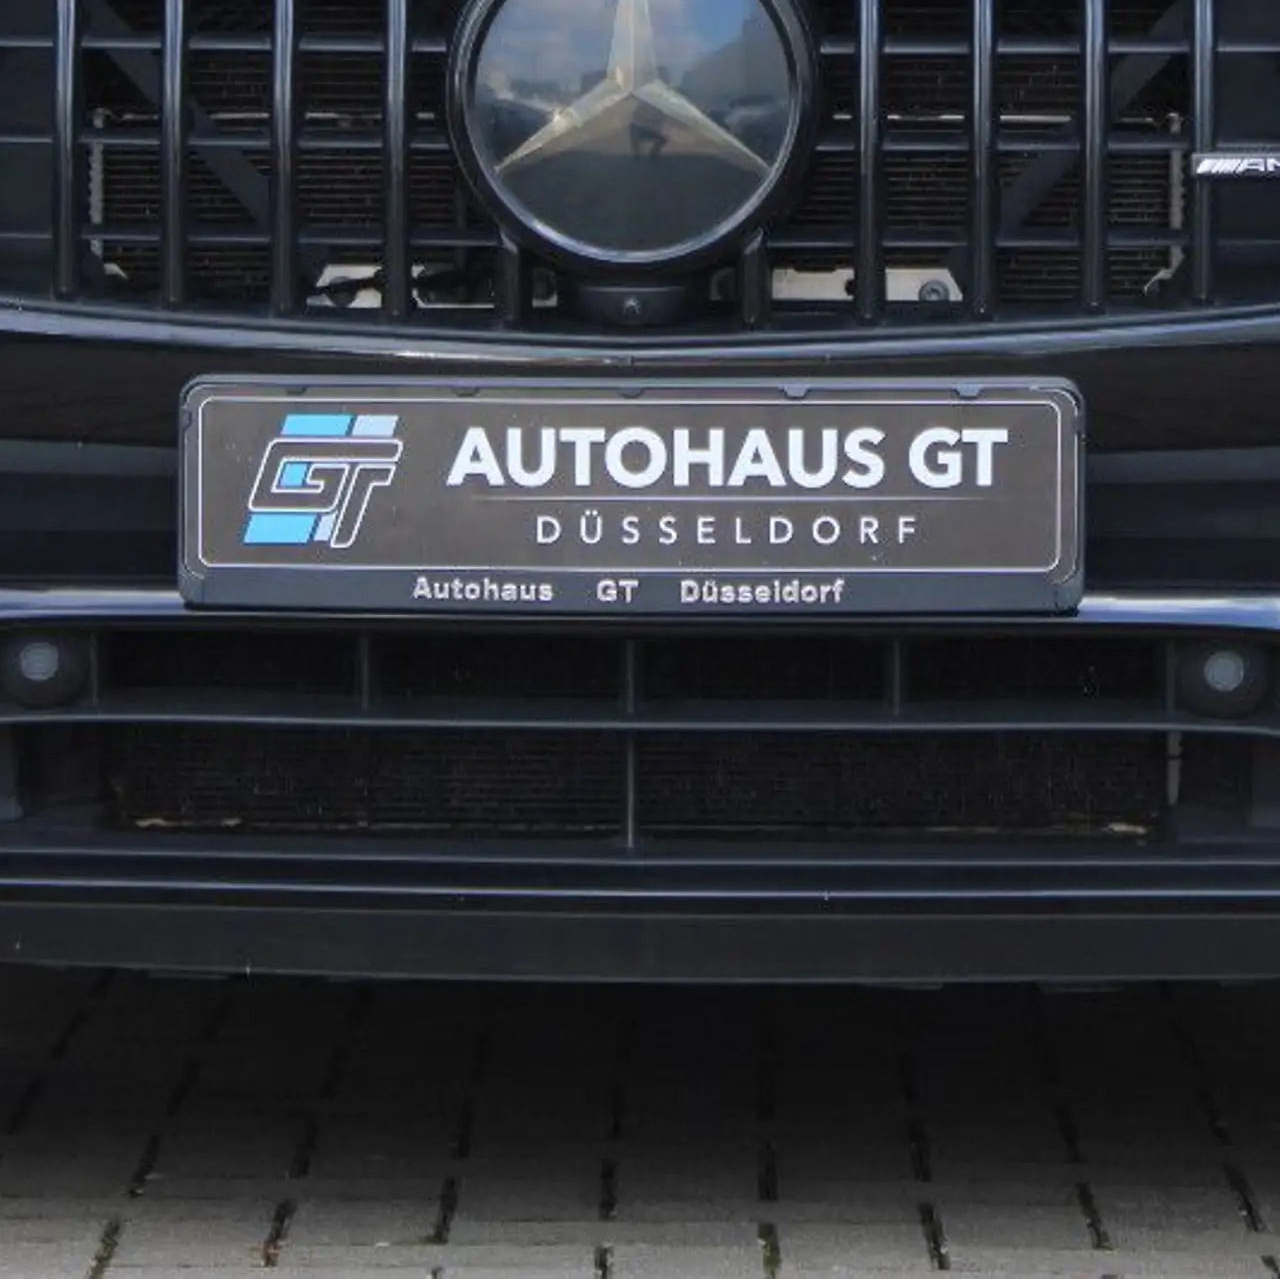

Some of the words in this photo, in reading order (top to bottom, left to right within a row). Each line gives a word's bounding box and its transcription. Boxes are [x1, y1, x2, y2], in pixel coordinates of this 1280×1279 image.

[446, 426, 886, 489] AUTOHAUS
[907, 426, 1009, 489] GT
[535, 508, 917, 545] DÜSSELDORF
[412, 576, 554, 603] Autohaus
[595, 579, 639, 603] GT
[679, 578, 846, 603] Düsseldorf
